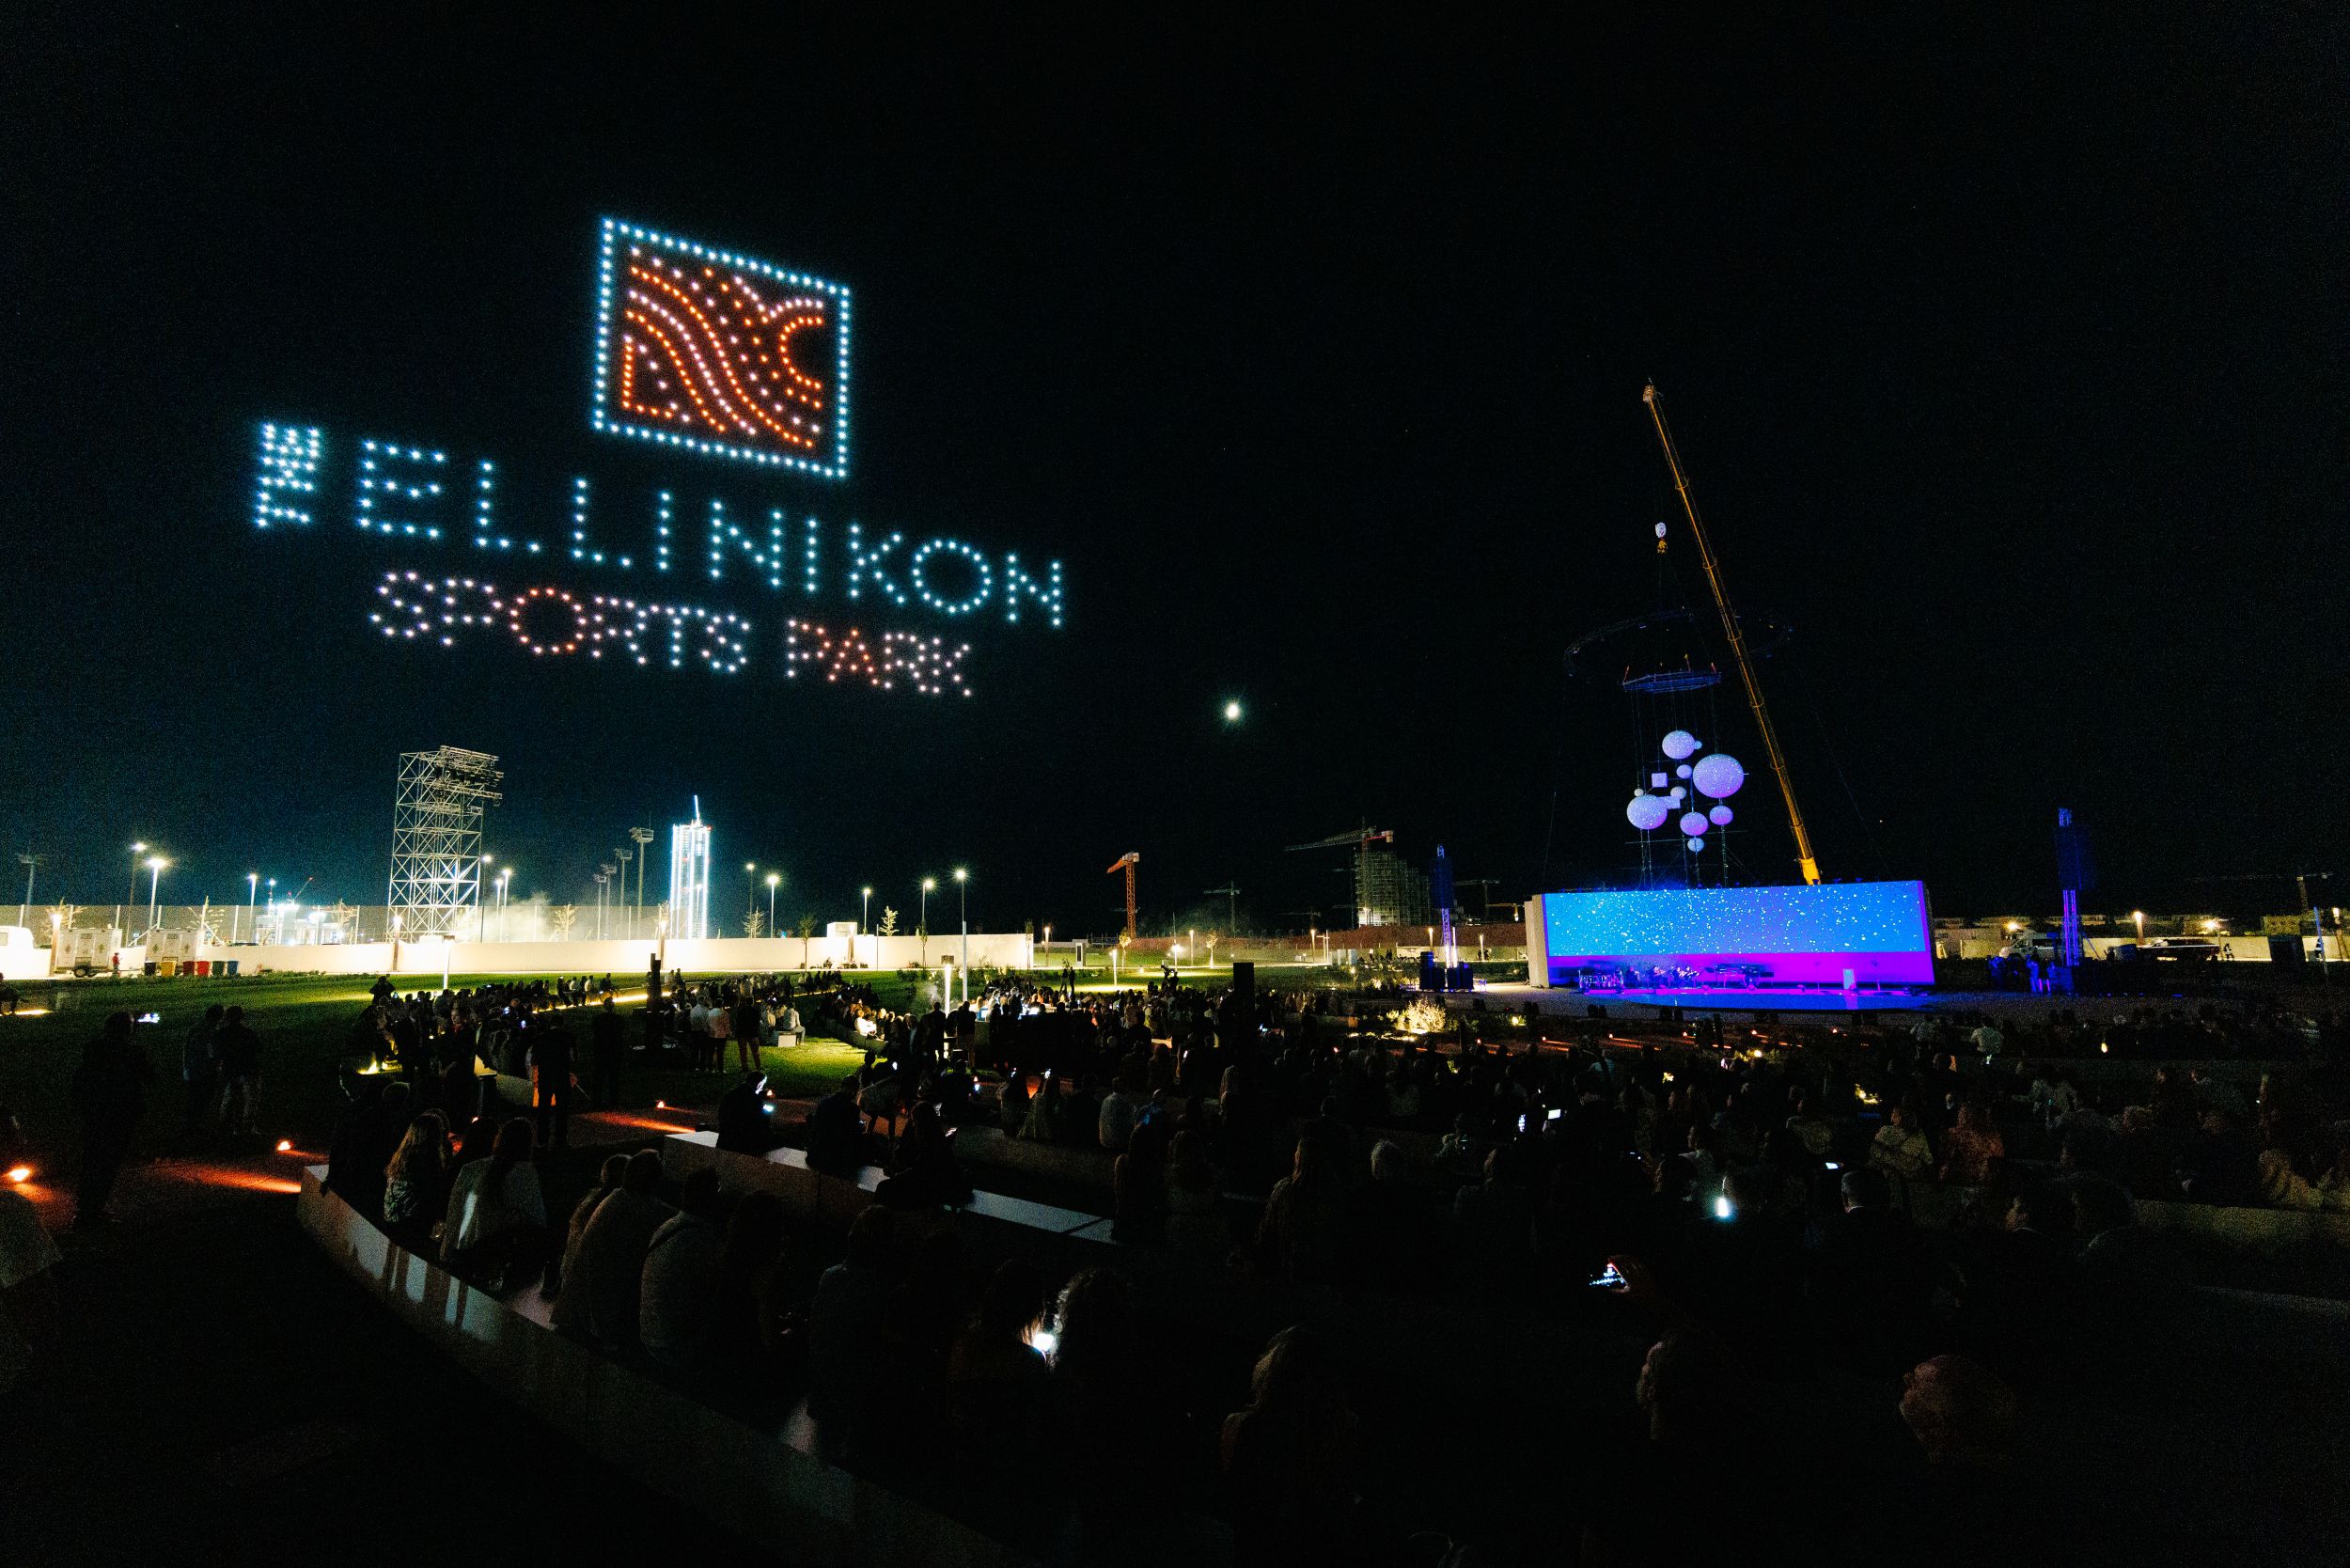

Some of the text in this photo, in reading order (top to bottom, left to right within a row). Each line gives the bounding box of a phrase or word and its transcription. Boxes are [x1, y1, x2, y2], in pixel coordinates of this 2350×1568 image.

[355, 438, 1063, 628] ELLINIKON
[368, 571, 972, 698] SPORTS PARK
